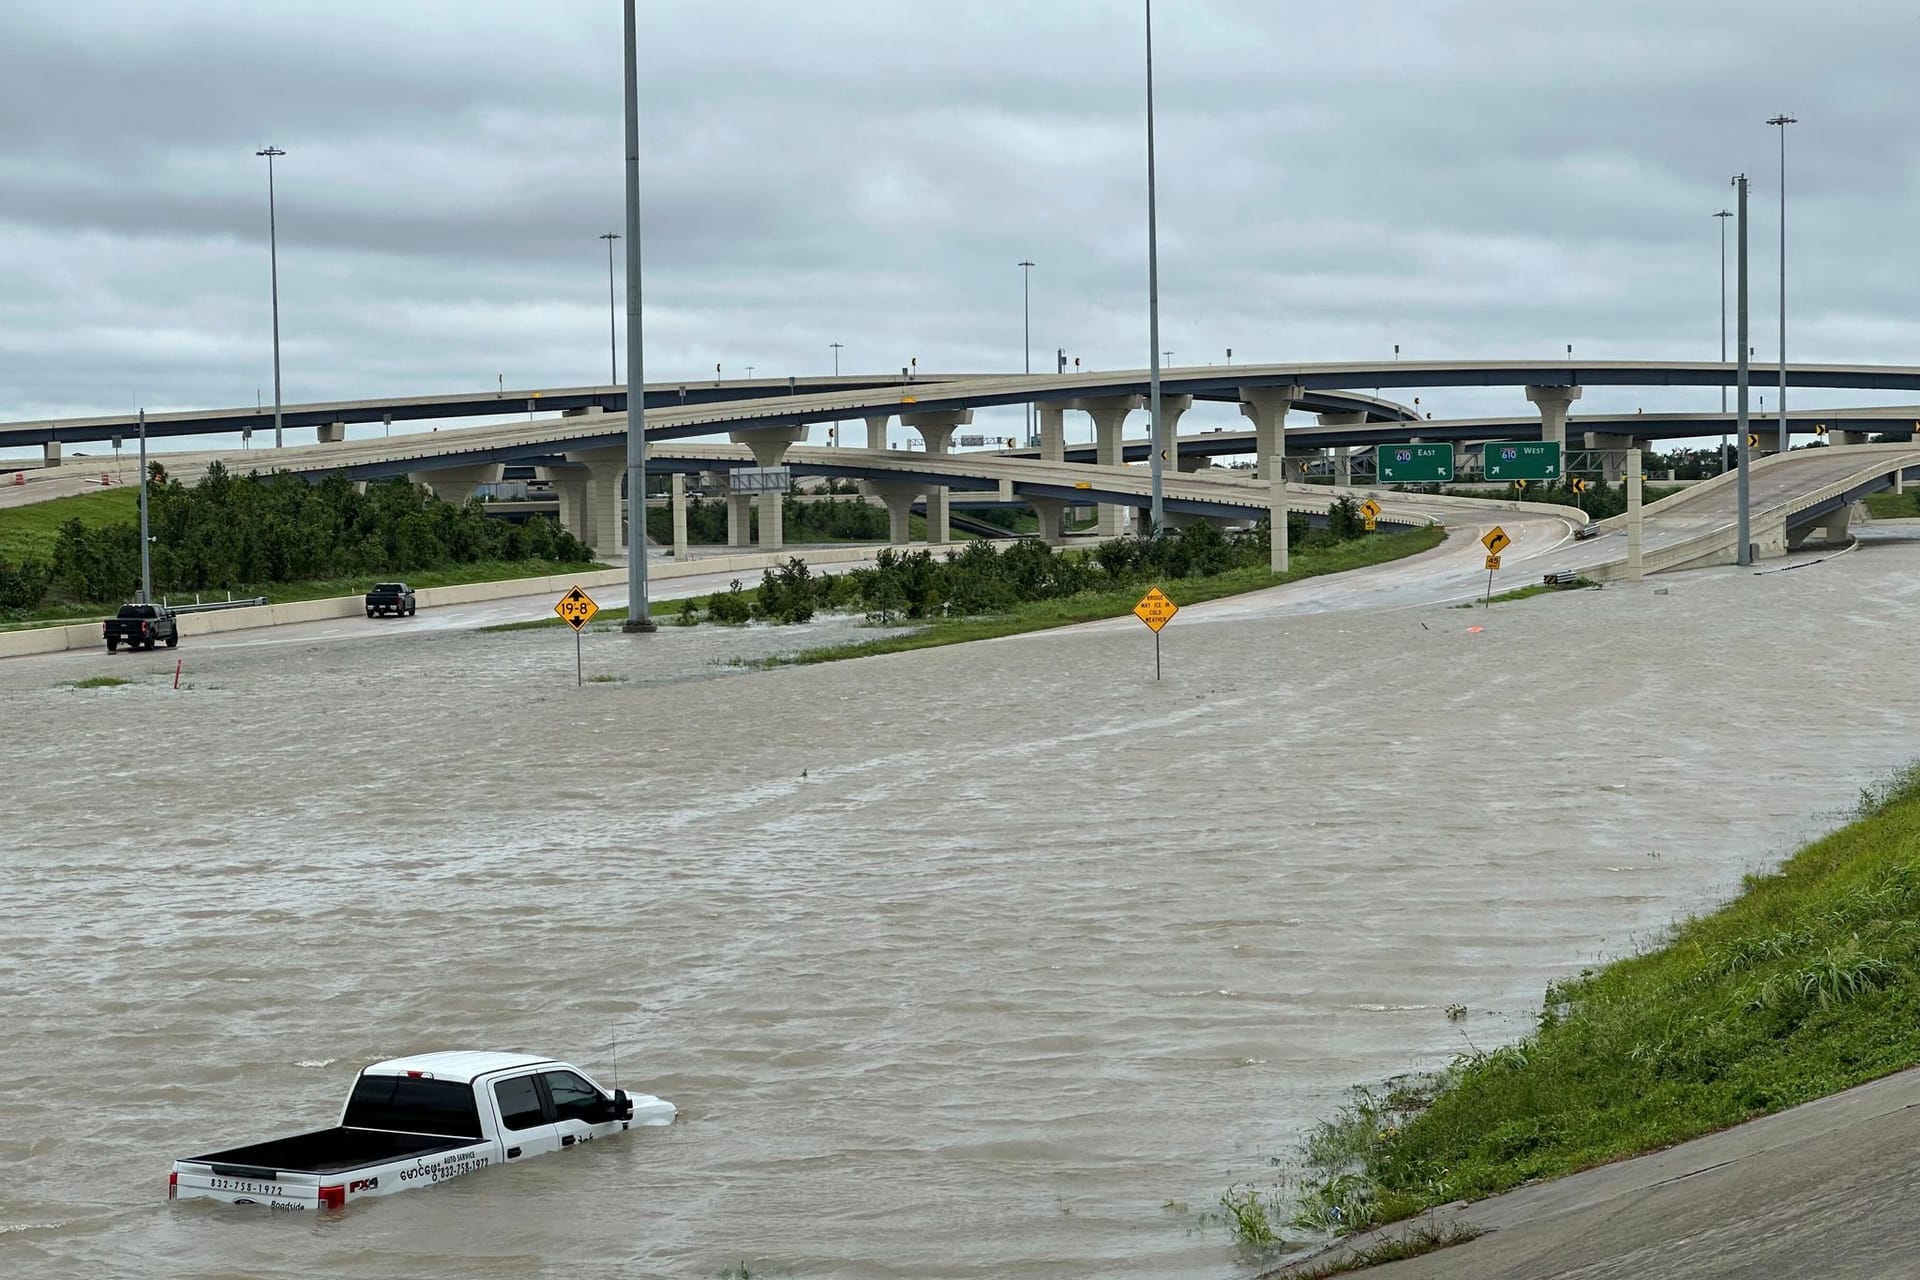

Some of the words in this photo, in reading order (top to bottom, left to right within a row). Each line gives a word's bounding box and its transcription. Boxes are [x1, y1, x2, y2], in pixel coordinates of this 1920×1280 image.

[1396, 452, 1411, 461] 610
[1501, 451, 1517, 460] 610
[1523, 447, 1544, 455] WEST
[443, 1154, 456, 1164] AUTO
[456, 1151, 475, 1162] SERVICE
[210, 1178, 283, 1196] 832-758-1972
[349, 1177, 379, 1194] FX4
